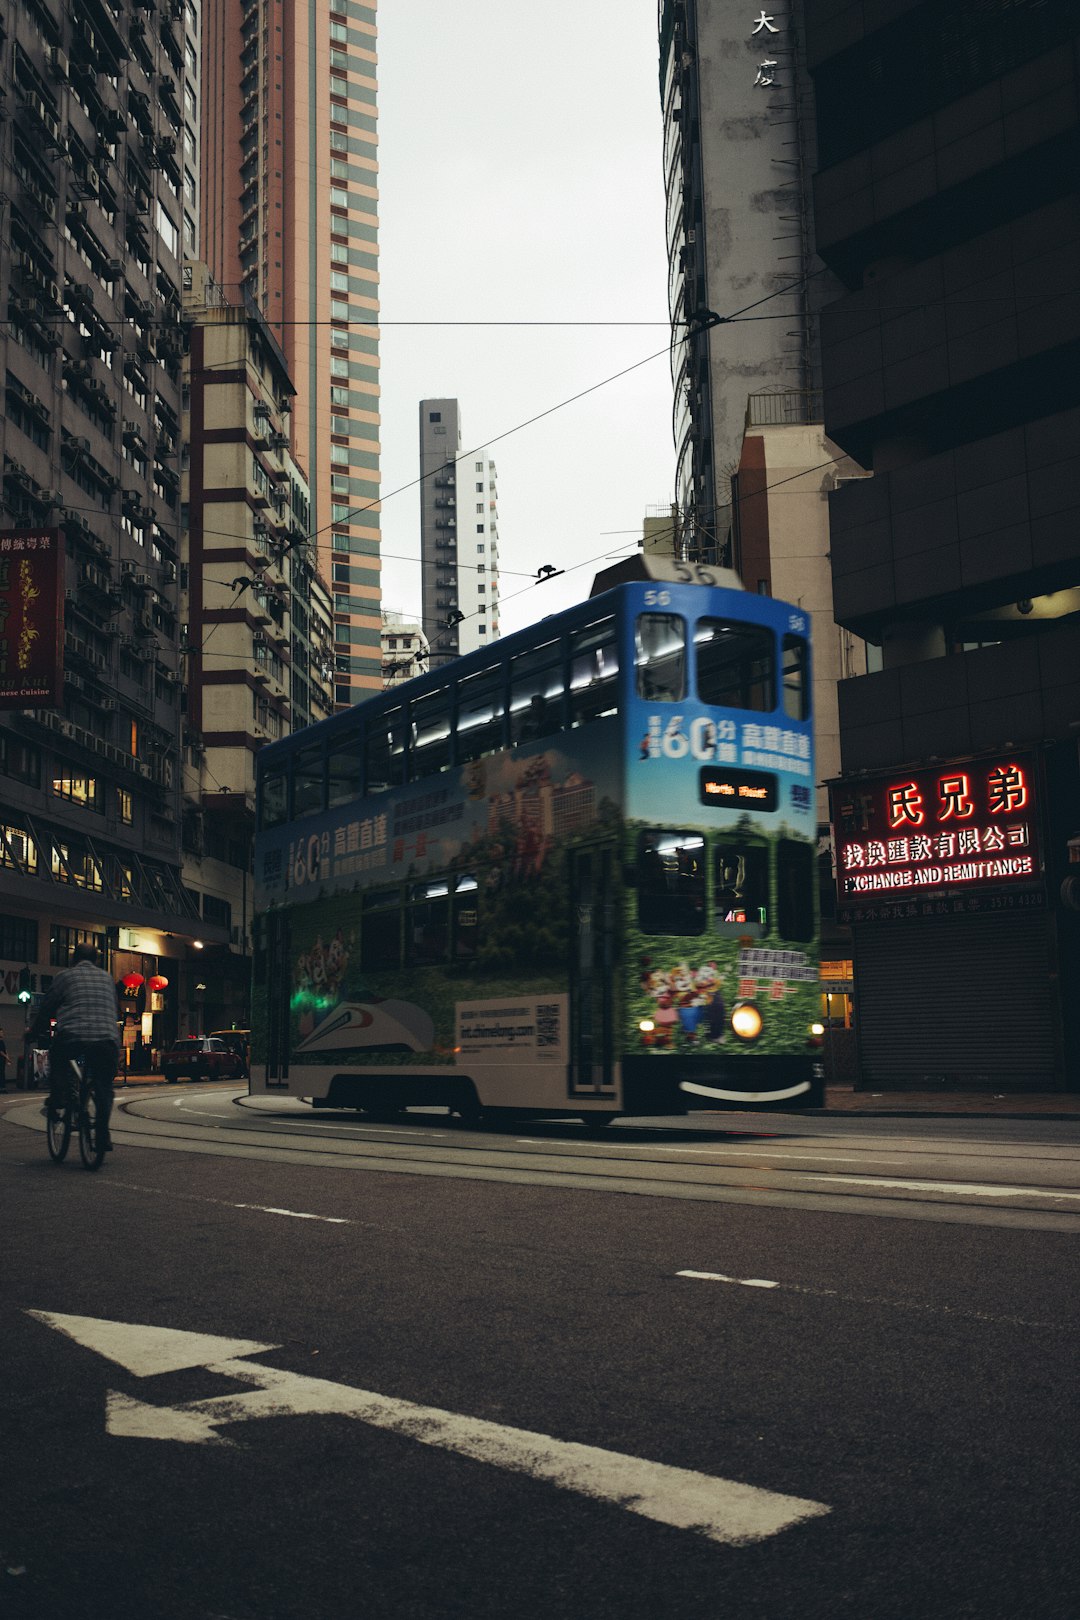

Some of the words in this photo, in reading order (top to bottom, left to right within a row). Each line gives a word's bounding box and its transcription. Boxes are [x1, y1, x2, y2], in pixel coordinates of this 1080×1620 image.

[20, 688, 50, 696] Cuisine
[843, 821, 1030, 869] 找換匯款有限公司
[844, 870, 912, 893] EXCHANGE
[914, 867, 942, 885] AND
[944, 857, 1032, 882] REMITTANCE
